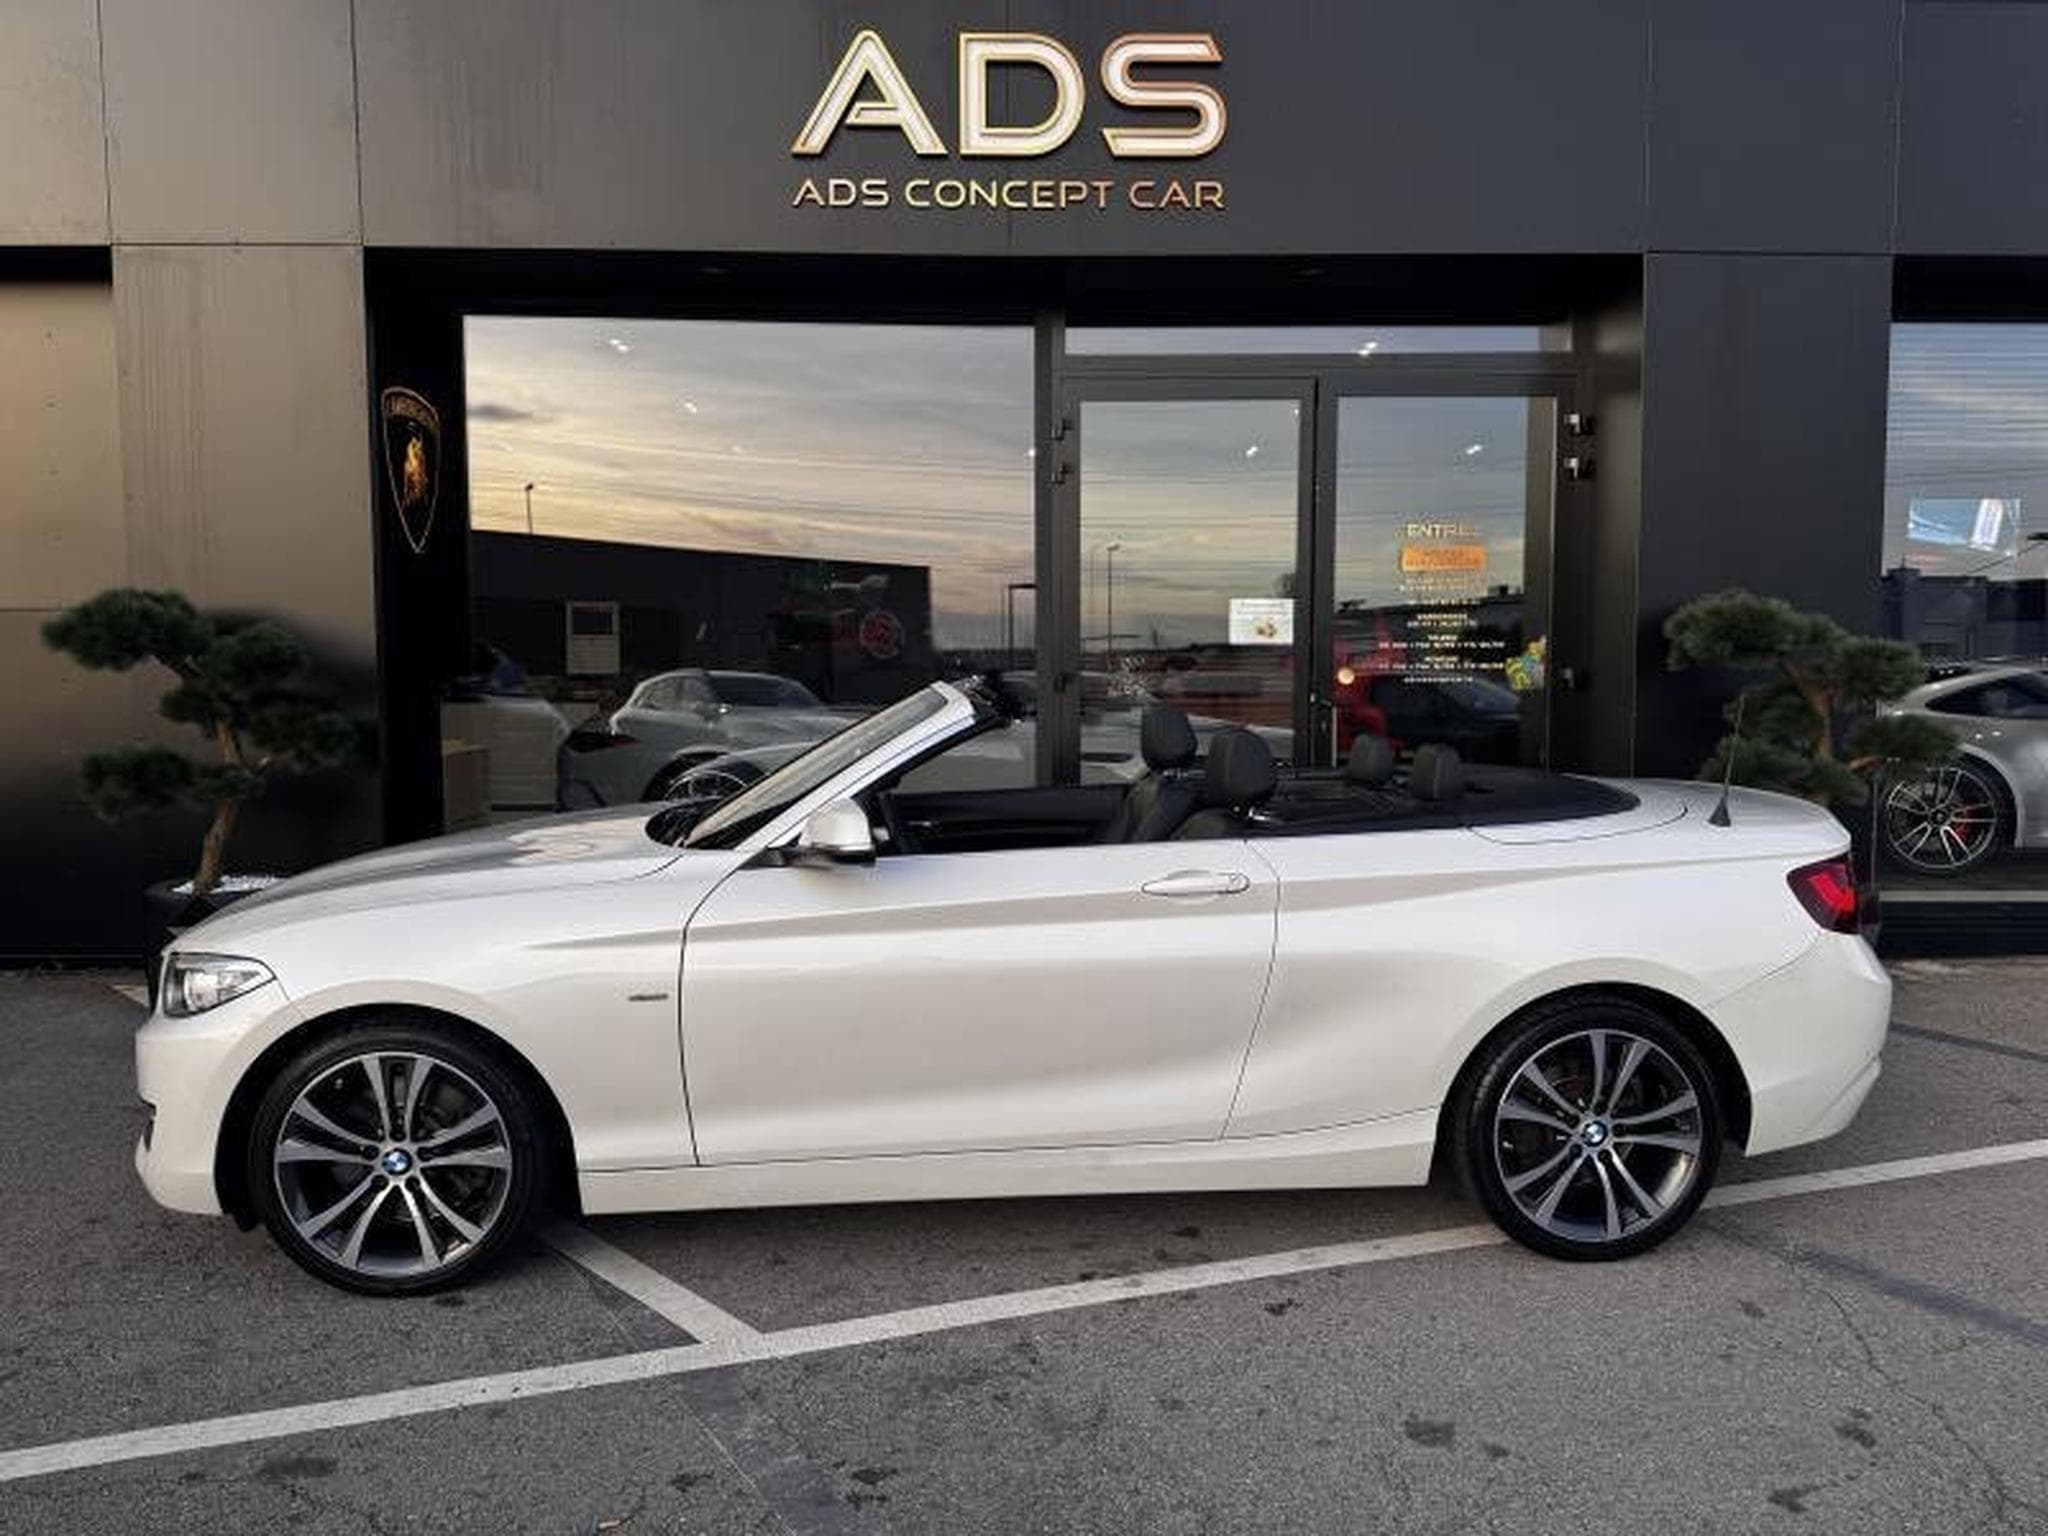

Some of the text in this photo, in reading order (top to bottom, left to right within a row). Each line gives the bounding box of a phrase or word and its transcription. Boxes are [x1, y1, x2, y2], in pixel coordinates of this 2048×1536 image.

[791, 29, 1228, 158] ADS
[792, 179, 1227, 210] ADS CONCEPT CAR
